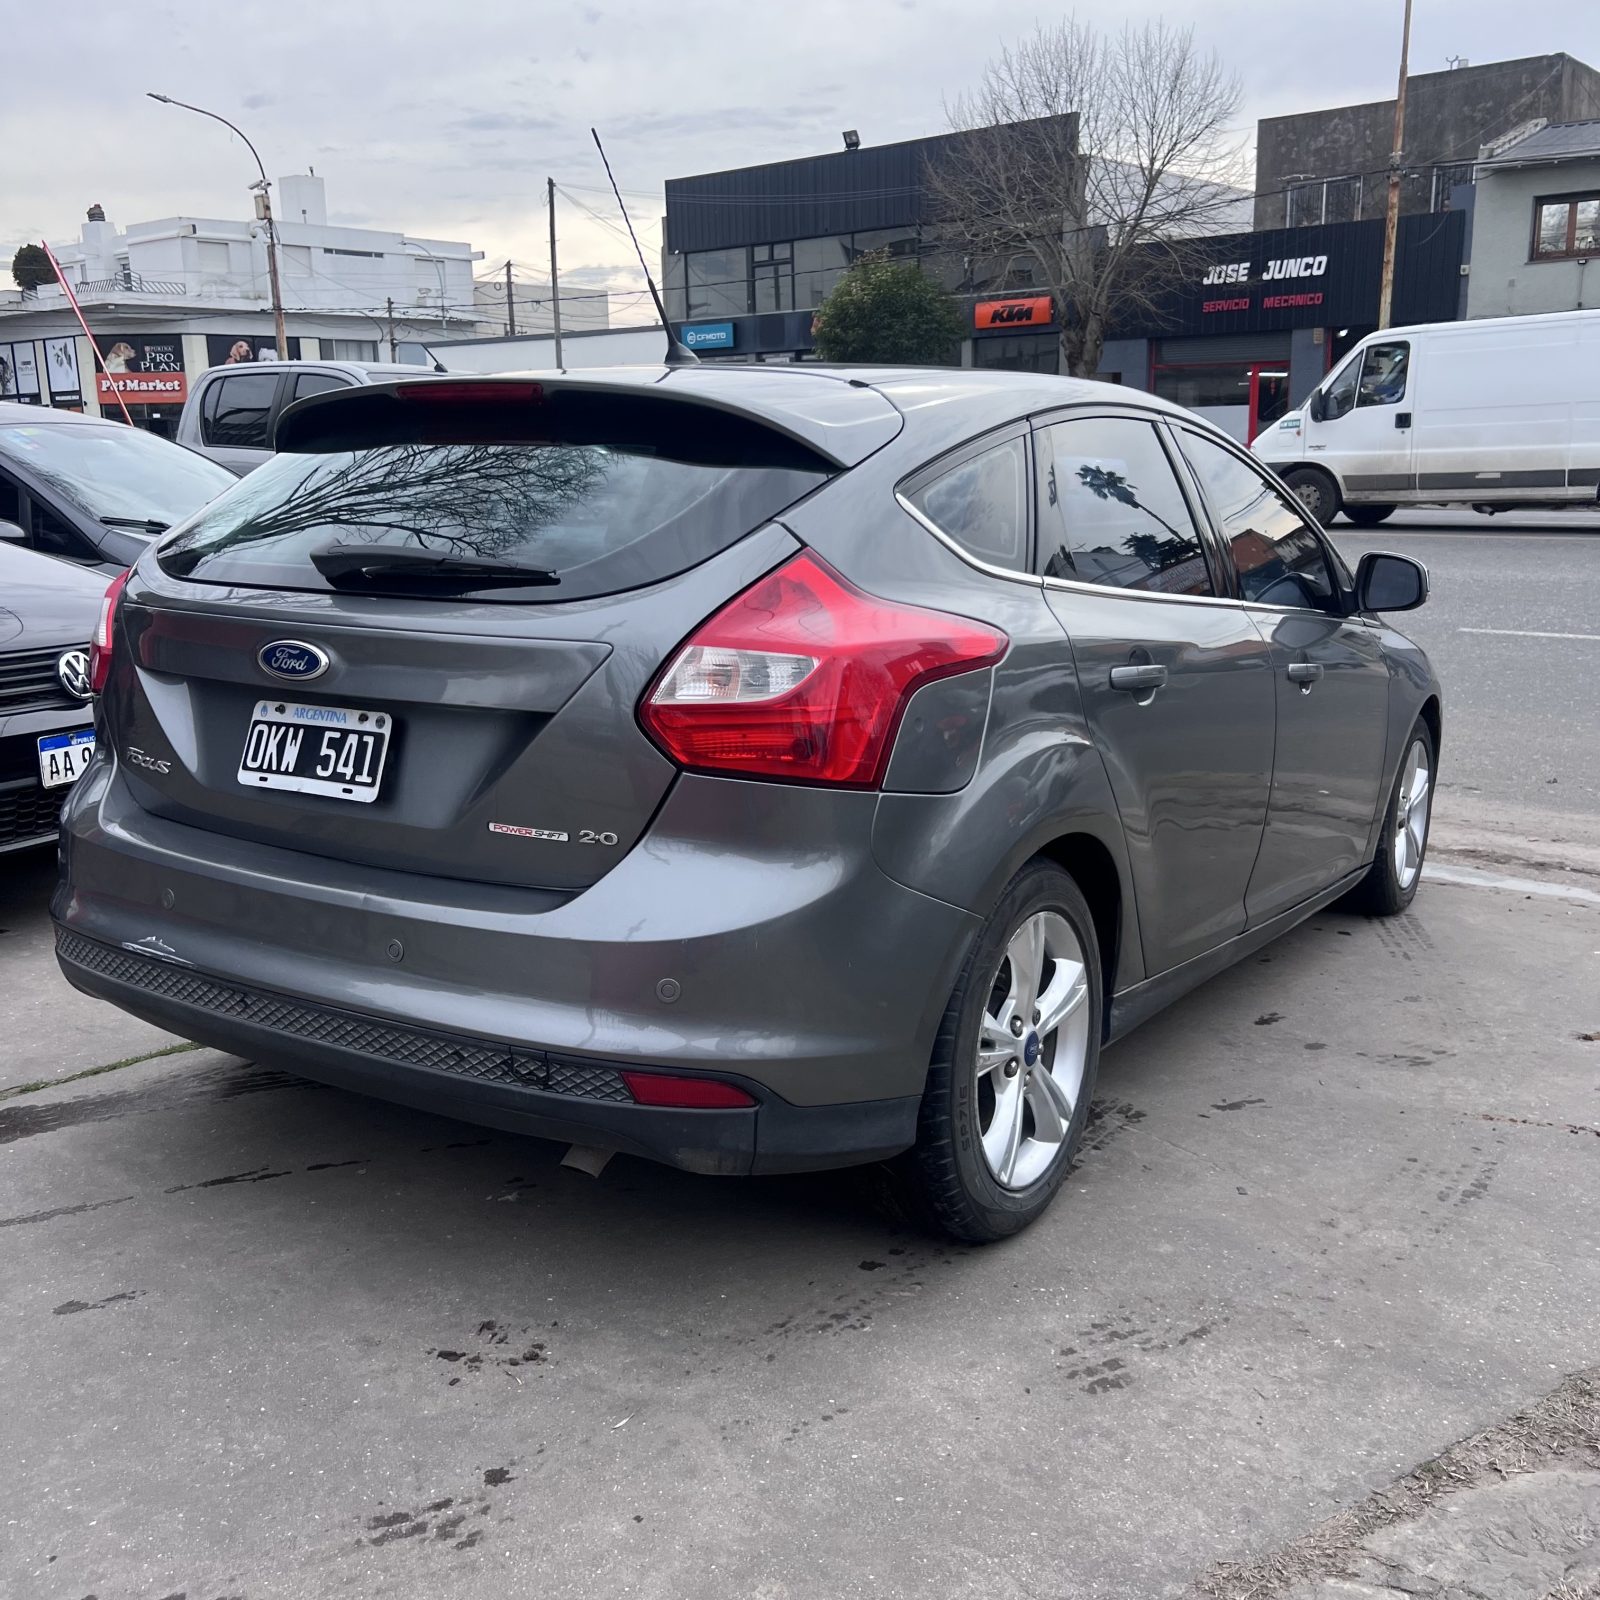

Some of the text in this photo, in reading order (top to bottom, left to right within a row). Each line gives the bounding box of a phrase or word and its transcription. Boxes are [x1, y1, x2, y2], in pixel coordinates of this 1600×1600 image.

[1202, 255, 1328, 285] JOSE JUNCO
[990, 303, 1034, 323] KTM
[1202, 292, 1323, 313] SERVICIO MECANICO
[697, 332, 726, 341] CFMOTO
[126, 379, 181, 391] Market
[271, 647, 307, 671] Ford
[293, 707, 347, 724] ARGENTINA
[246, 723, 375, 784] OKW 541
[50, 750, 75, 781] AA
